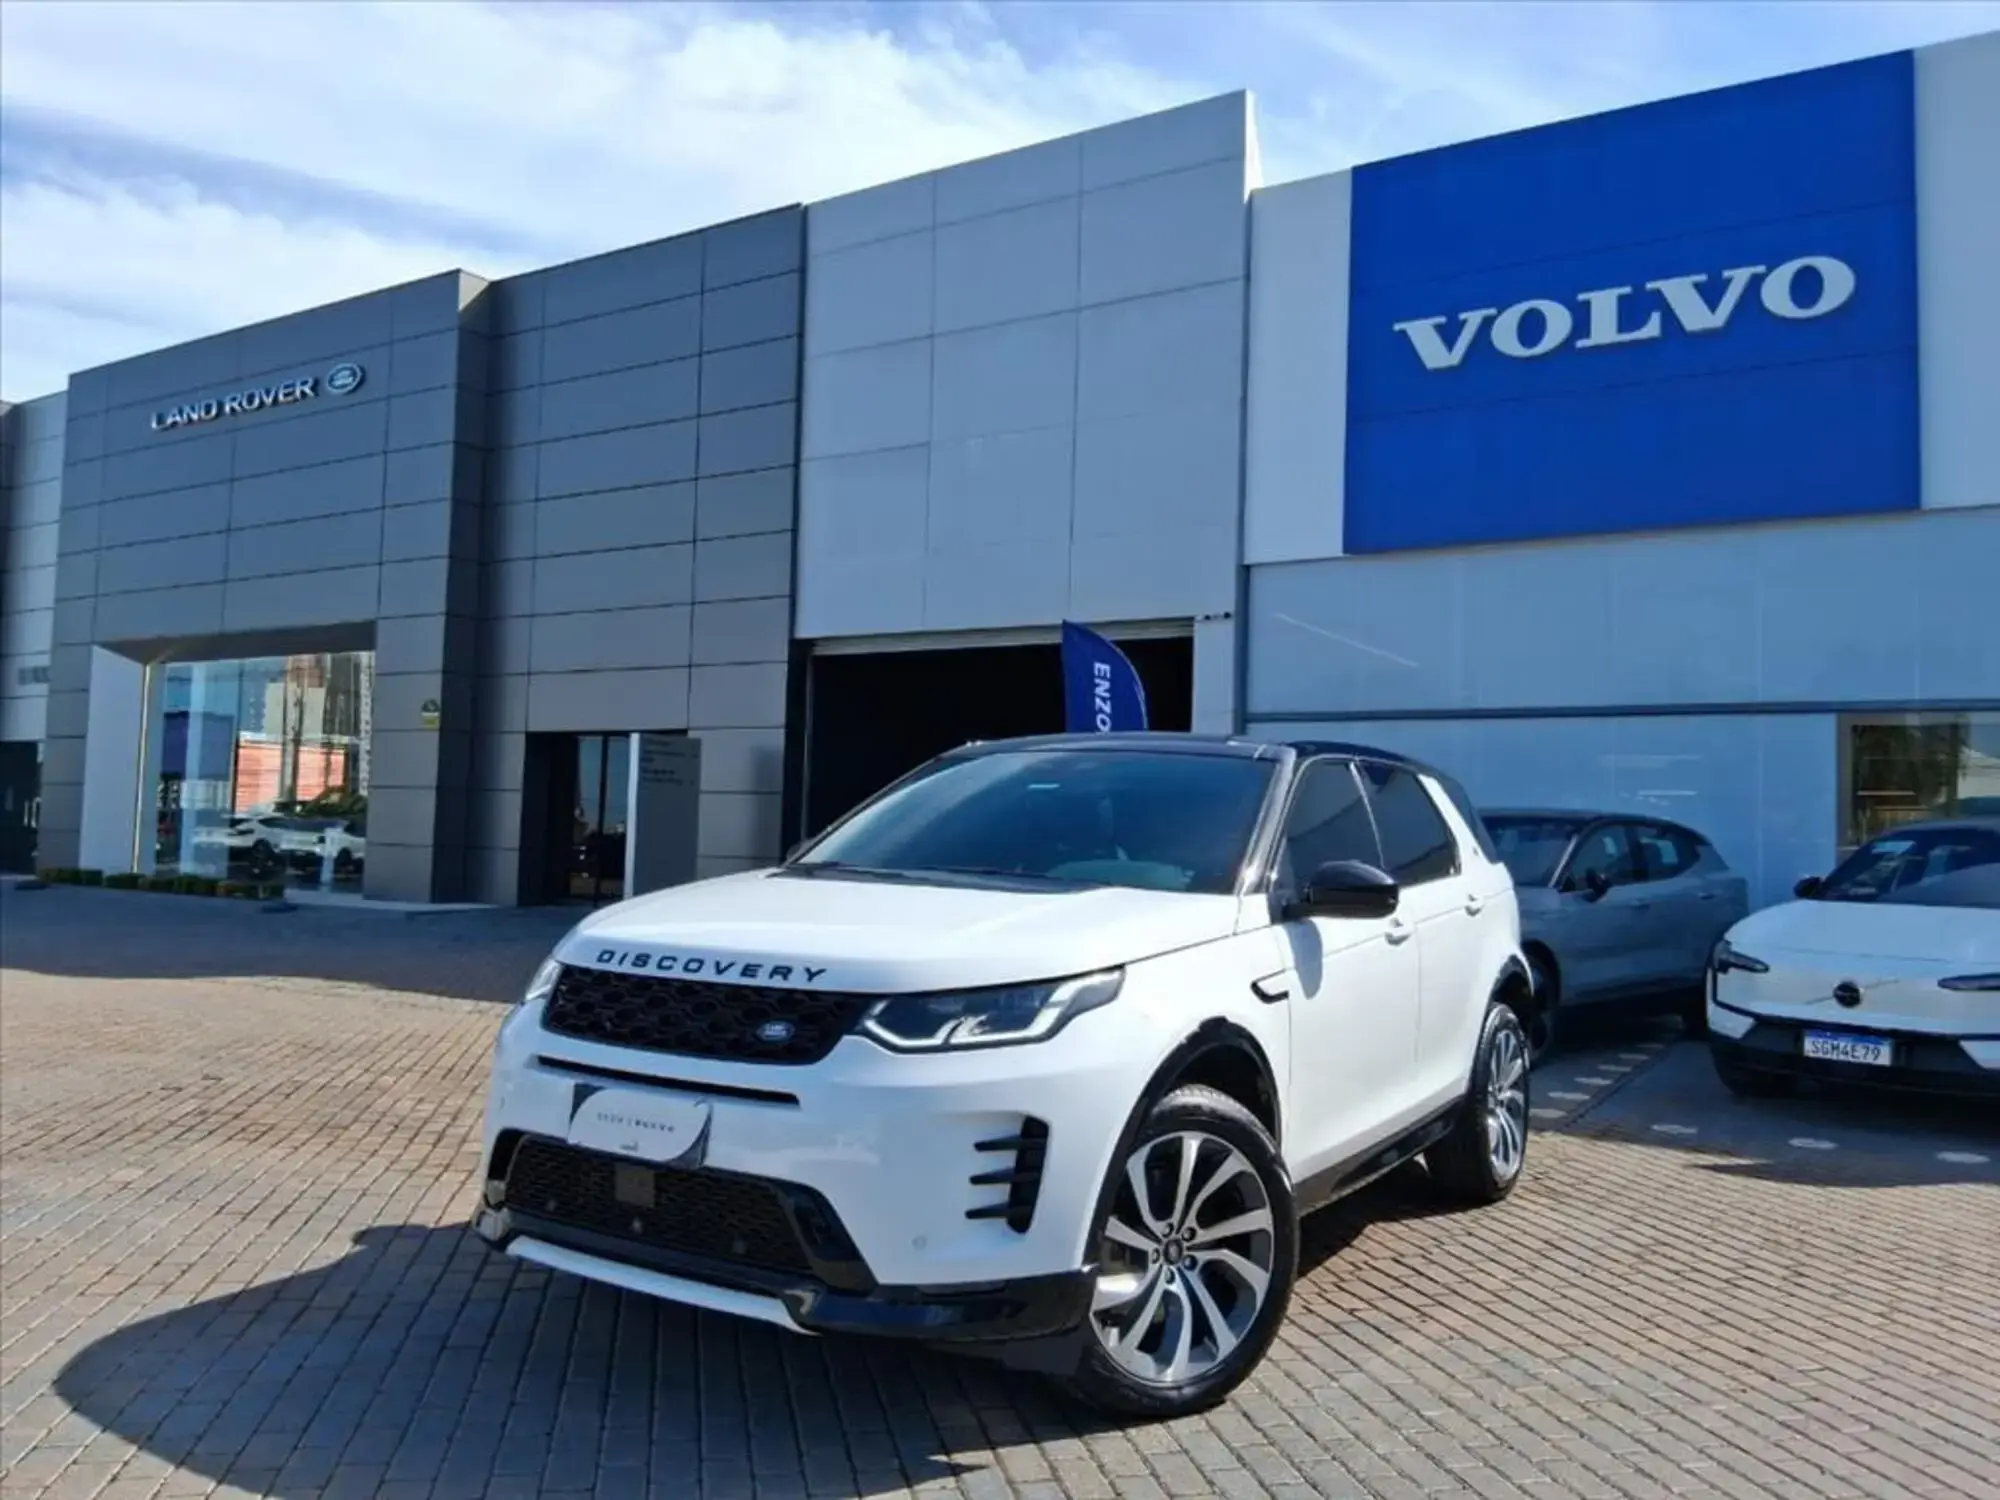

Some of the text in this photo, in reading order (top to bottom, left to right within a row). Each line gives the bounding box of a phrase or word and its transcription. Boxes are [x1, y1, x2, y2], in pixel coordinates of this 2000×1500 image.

[1393, 255, 1857, 371] VOLVO
[151, 400, 218, 430] LAND
[224, 376, 315, 416] ROVER
[1093, 661, 1112, 733] ENZO
[596, 949, 828, 983] DISCOVERY
